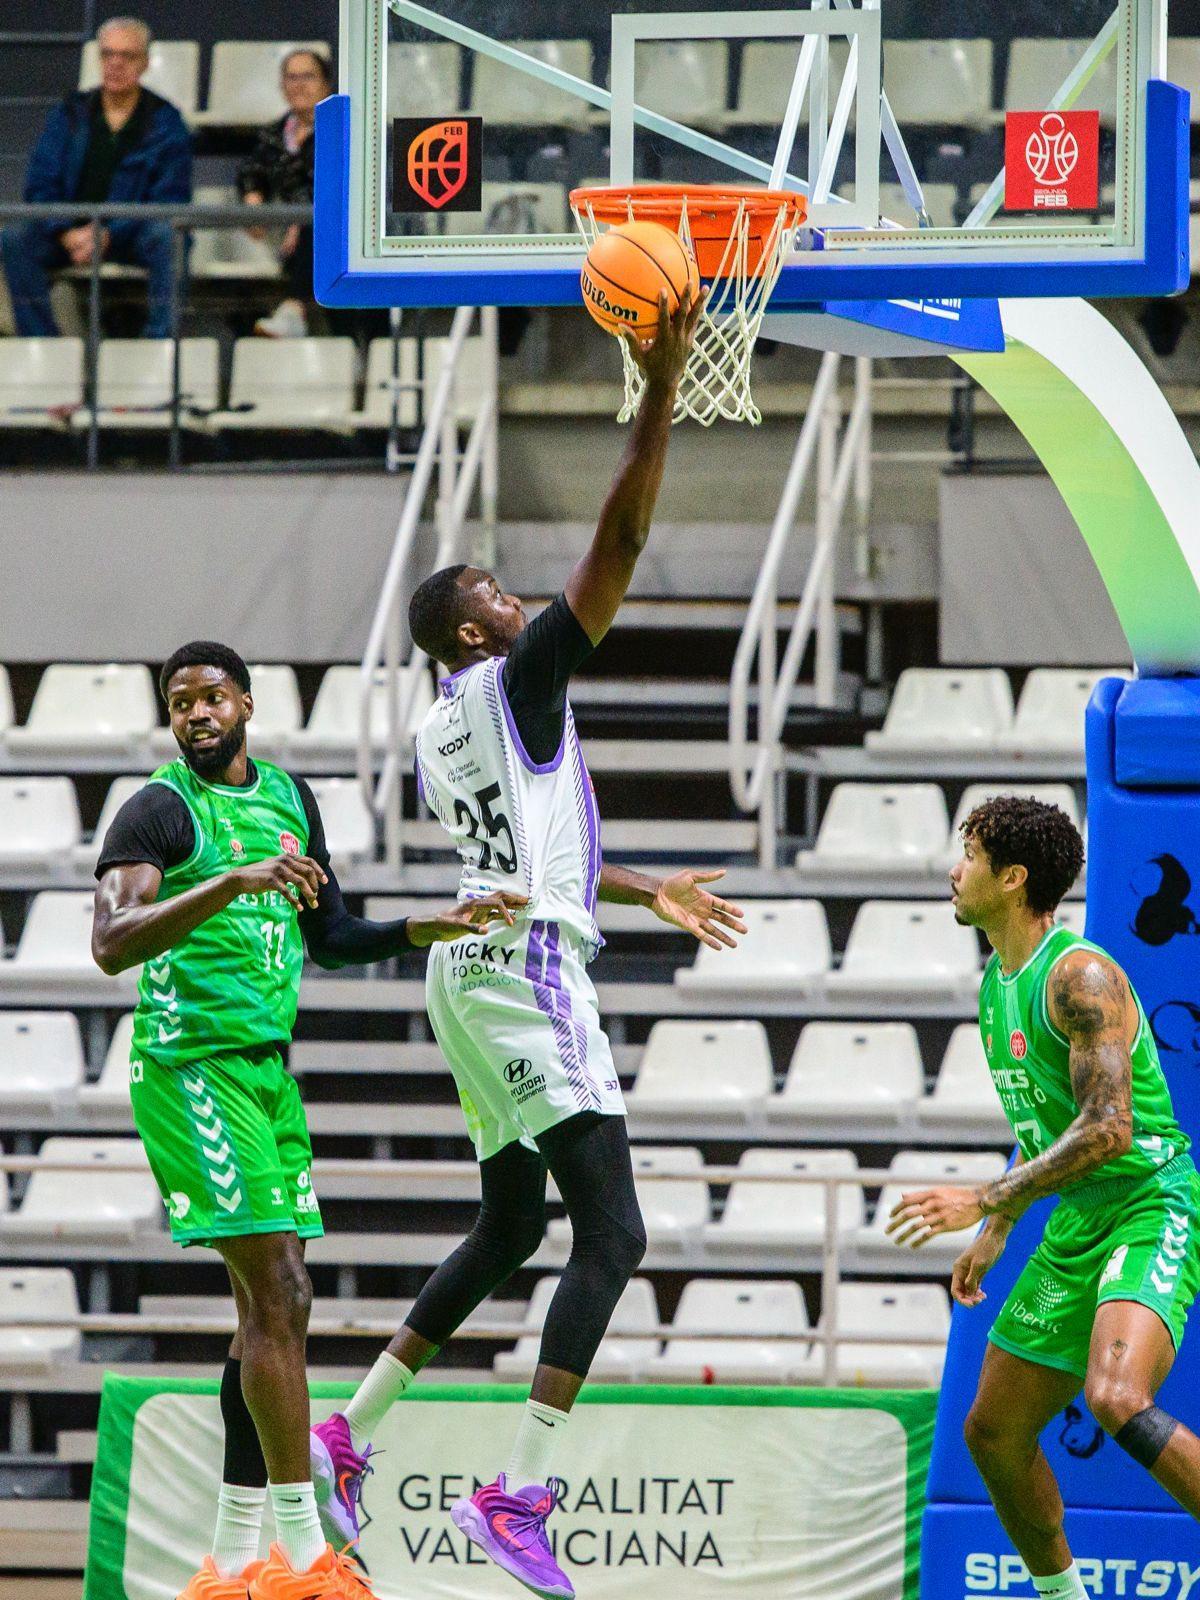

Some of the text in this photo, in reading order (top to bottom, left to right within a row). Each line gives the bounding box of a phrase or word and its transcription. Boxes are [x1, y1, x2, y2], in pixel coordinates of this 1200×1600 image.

[444, 126, 463, 136] FEB
[1033, 195, 1069, 207] FEB
[582, 270, 638, 322] Wilson
[438, 731, 472, 757] KODY
[453, 781, 517, 874] 35
[450, 942, 515, 965] VICKY
[400, 1527, 724, 1567] VALCIANA
